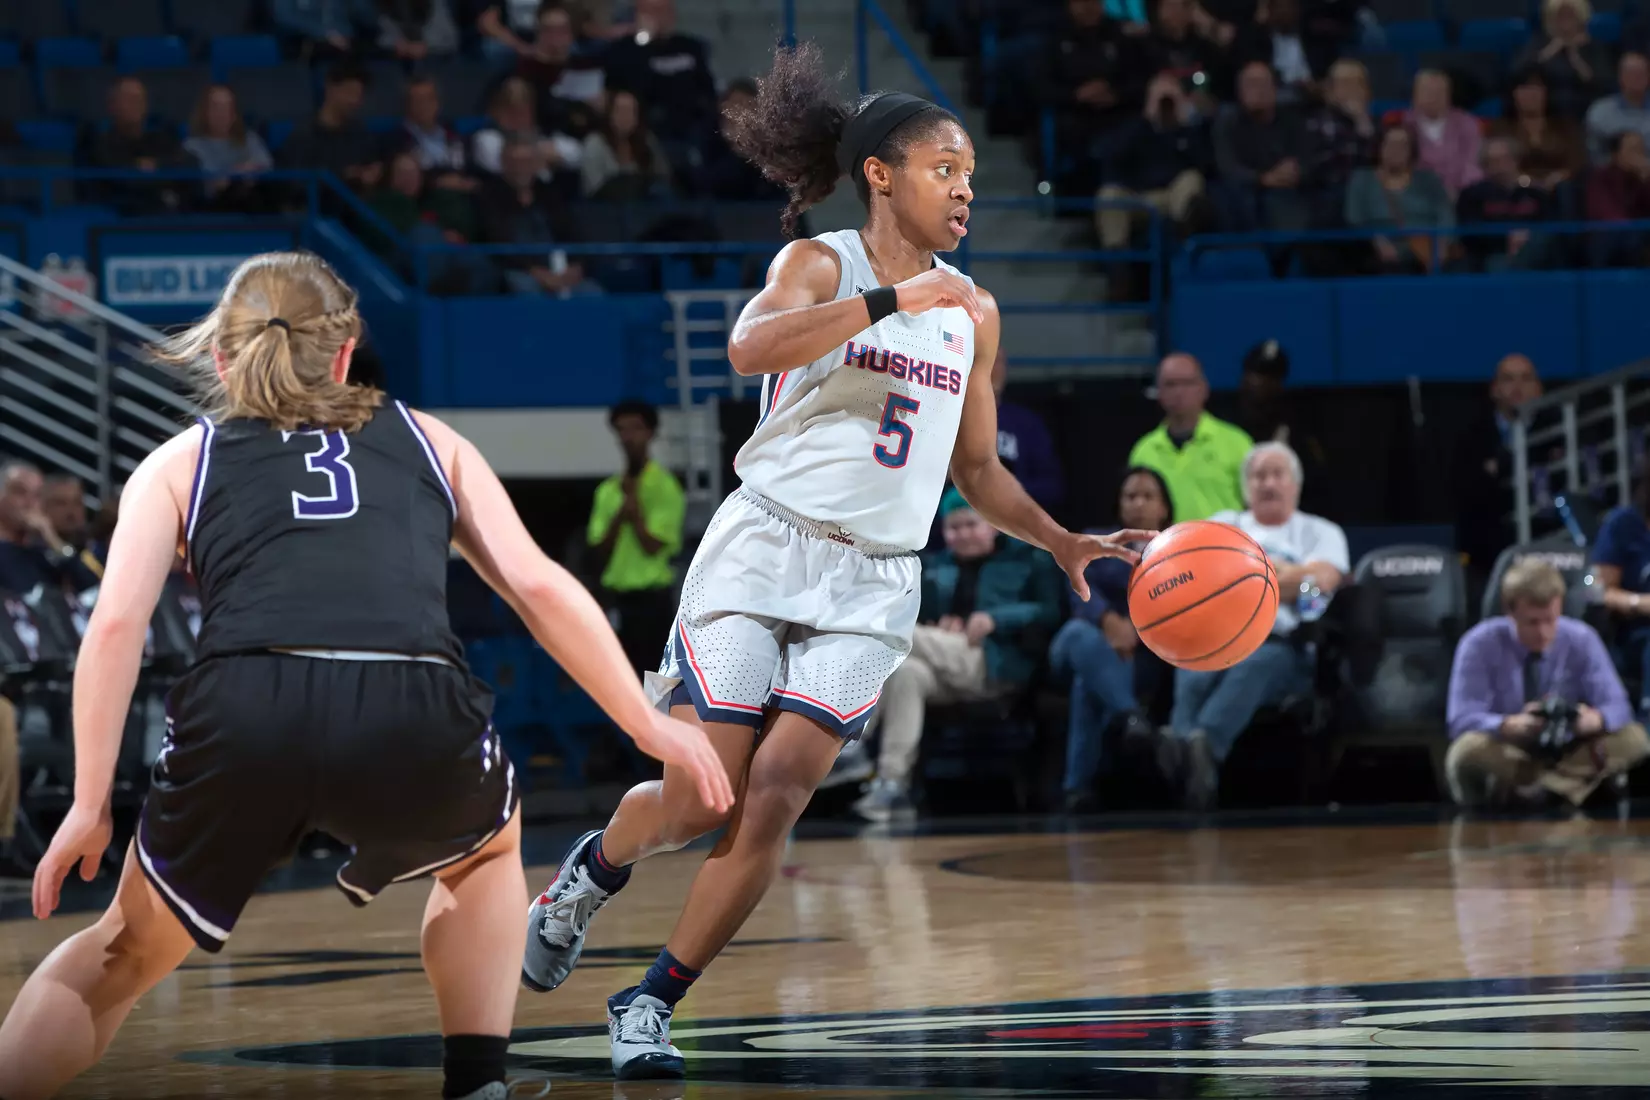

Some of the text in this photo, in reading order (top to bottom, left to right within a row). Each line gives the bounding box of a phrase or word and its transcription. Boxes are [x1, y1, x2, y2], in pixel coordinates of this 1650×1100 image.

[115, 267, 181, 294] BUD
[844, 341, 962, 395] HUSKIES
[872, 391, 921, 470] 5
[281, 426, 360, 519] 3
[827, 532, 855, 546] UCONN
[1372, 557, 1444, 577] UCONN
[1148, 570, 1195, 601] UCONN
